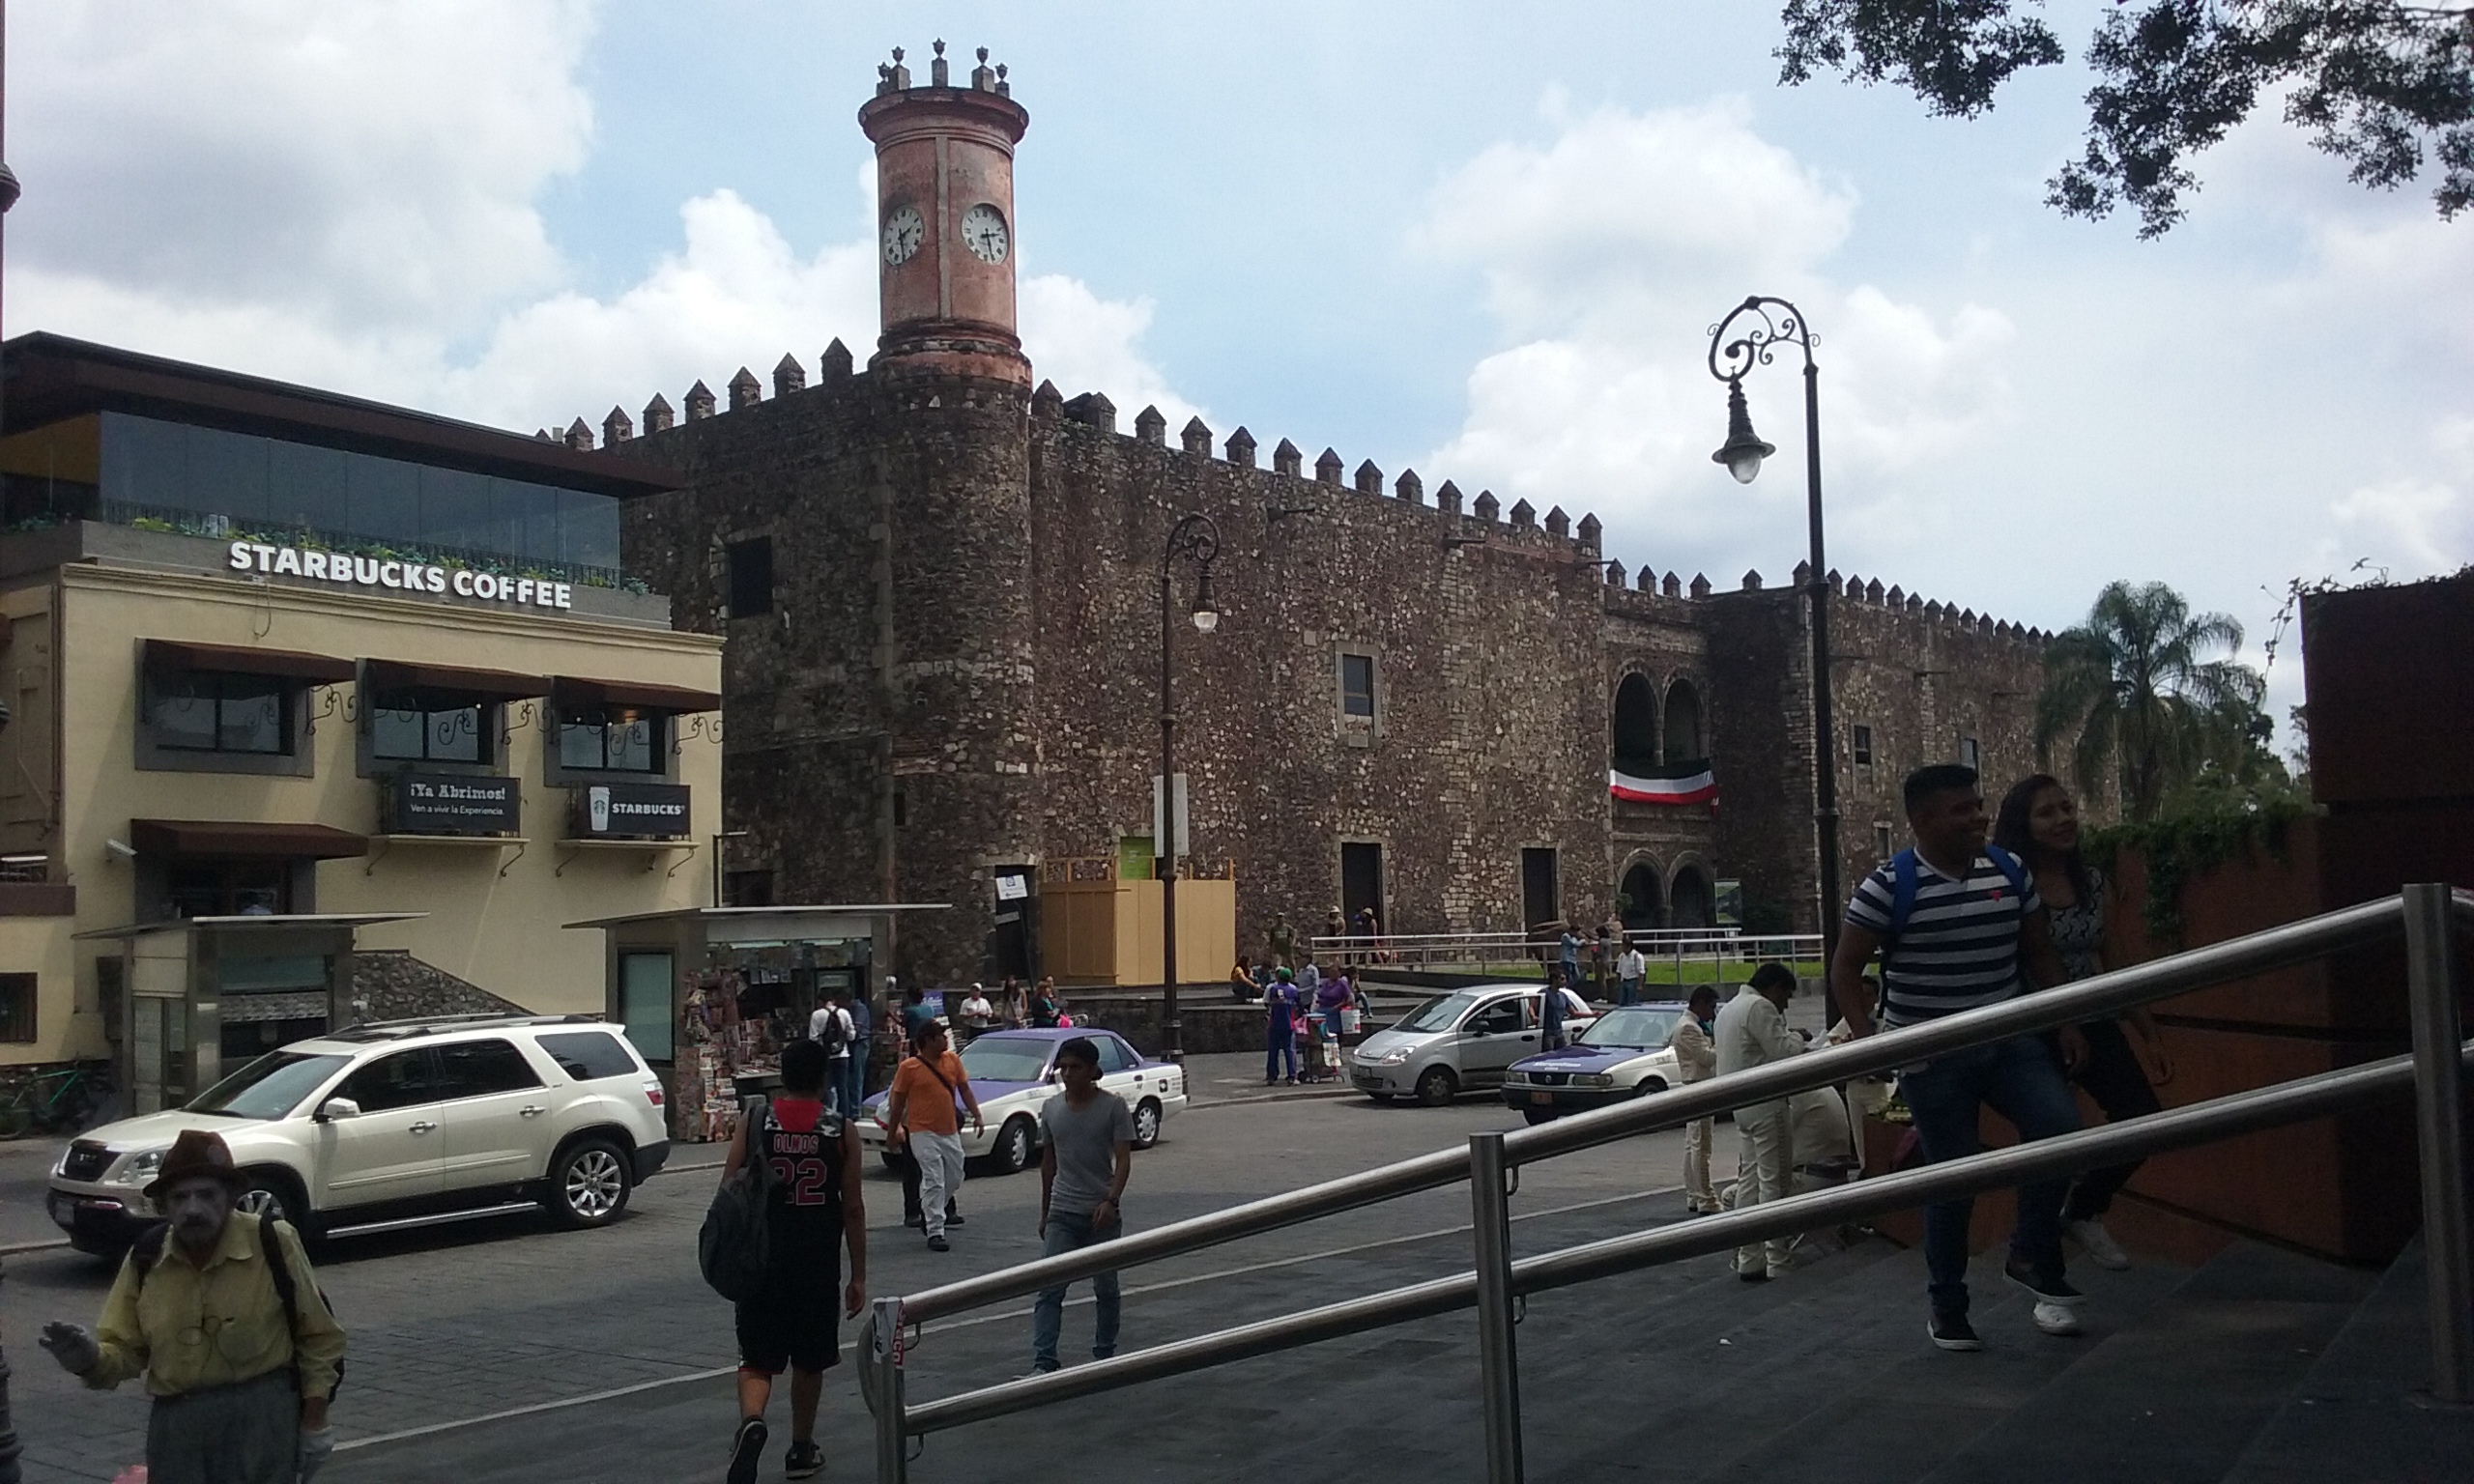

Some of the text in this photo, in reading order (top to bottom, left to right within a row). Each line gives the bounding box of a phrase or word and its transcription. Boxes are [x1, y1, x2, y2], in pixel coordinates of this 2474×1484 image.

[230, 541, 572, 609] STARBUCKS COFFEE
[411, 784, 505, 800] ¡Ya Abrimos!
[411, 804, 426, 813] Ven
[451, 805, 459, 813] la
[774, 1133, 819, 1154] OLMOS
